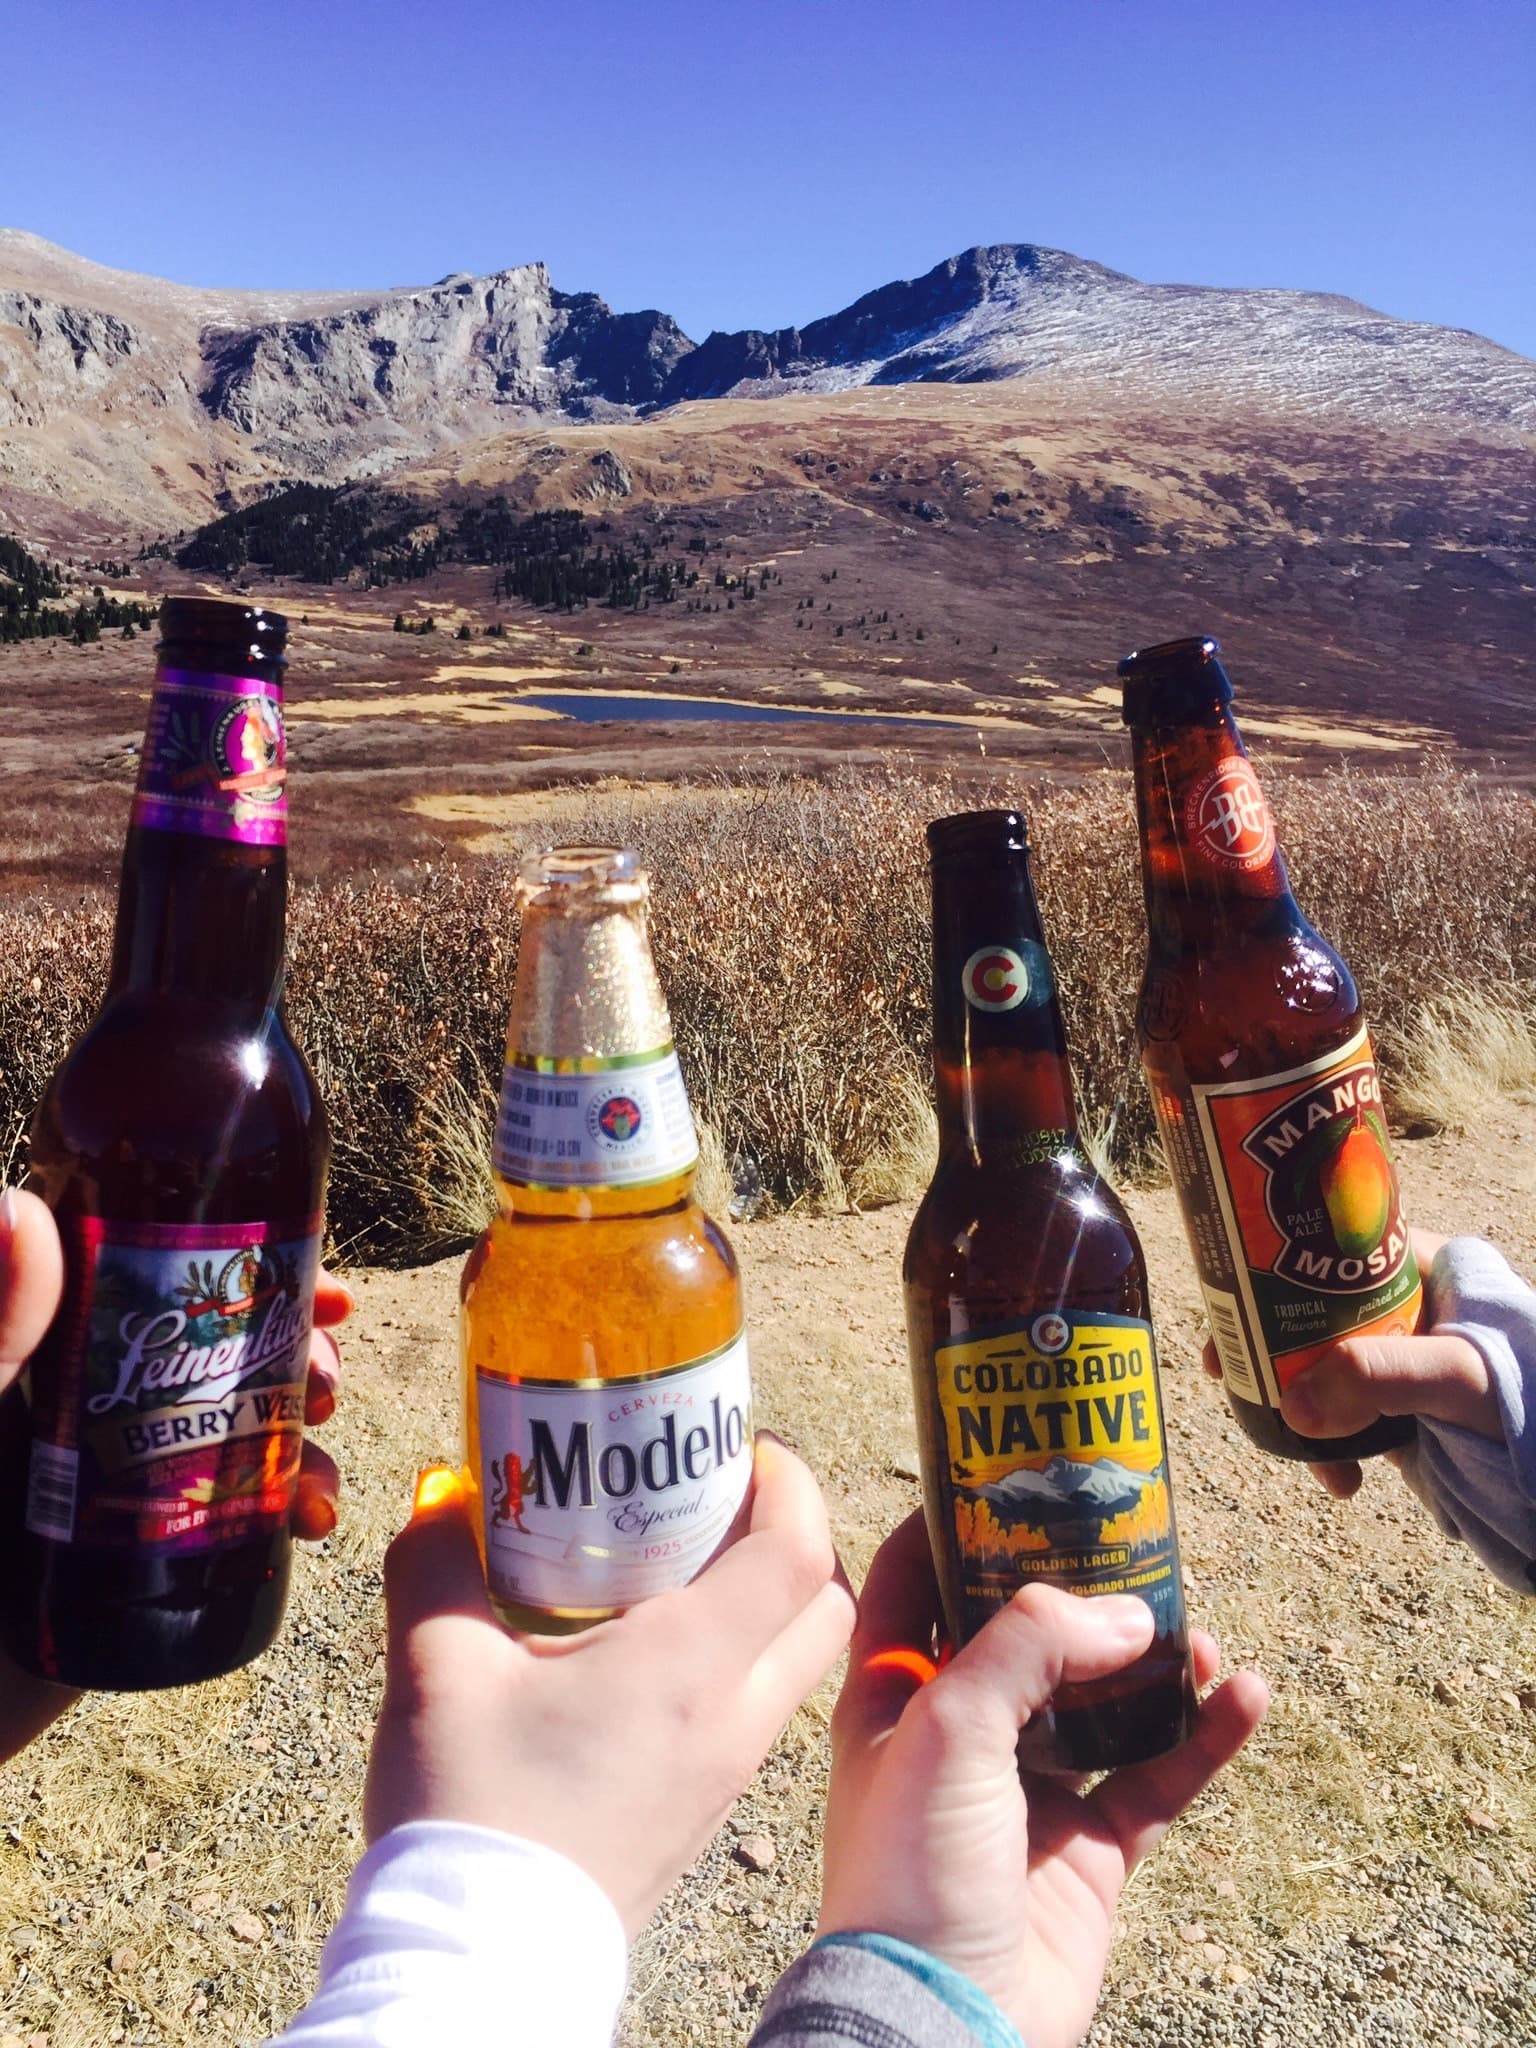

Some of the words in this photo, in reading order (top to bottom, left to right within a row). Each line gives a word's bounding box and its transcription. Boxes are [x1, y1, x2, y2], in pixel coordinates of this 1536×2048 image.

[1264, 1073, 1381, 1158] MANGO
[1287, 1208, 1324, 1226] PALE
[1295, 1221, 1322, 1237] ALE
[1274, 1299, 1327, 1319] TROPICAL
[1356, 1288, 1393, 1322] paired
[953, 1348, 1144, 1394] COLORADO
[608, 1392, 695, 1423] CERVEZA
[124, 1401, 245, 1455] BERRY
[957, 1390, 1150, 1460] NATIVE
[529, 1391, 743, 1510] Modelo
[606, 1488, 706, 1536] Especial
[644, 1540, 682, 1561] 1925
[1021, 1555, 1081, 1573] GOLDEN
[1083, 1550, 1127, 1568] LAGER
[1069, 1578, 1125, 1596] COLORADO
